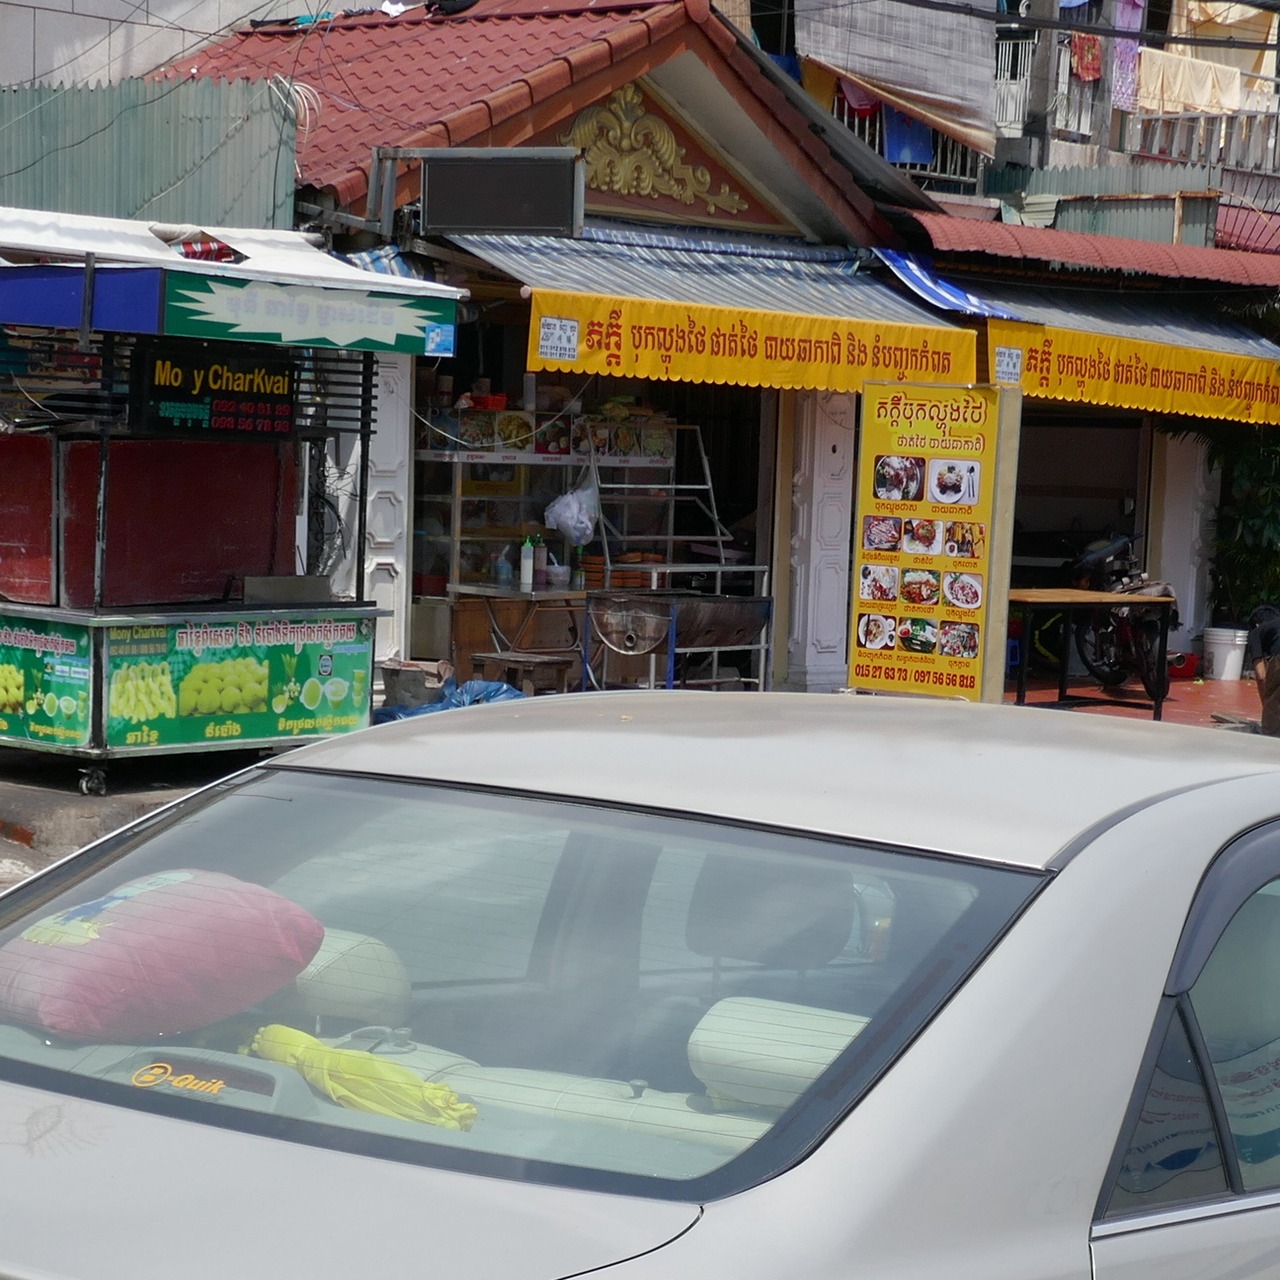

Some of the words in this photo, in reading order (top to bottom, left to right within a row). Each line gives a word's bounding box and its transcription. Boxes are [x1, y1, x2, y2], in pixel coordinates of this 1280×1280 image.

[846, 332, 868, 367] និង
[154, 358, 204, 395] Moy
[855, 664, 870, 678] 015
[872, 666, 882, 679] 27
[884, 667, 895, 680] 63
[897, 668, 908, 682] 73
[914, 670, 931, 684] 097
[932, 672, 944, 685] 56
[945, 674, 957, 687] 56
[959, 675, 976, 689] 818
